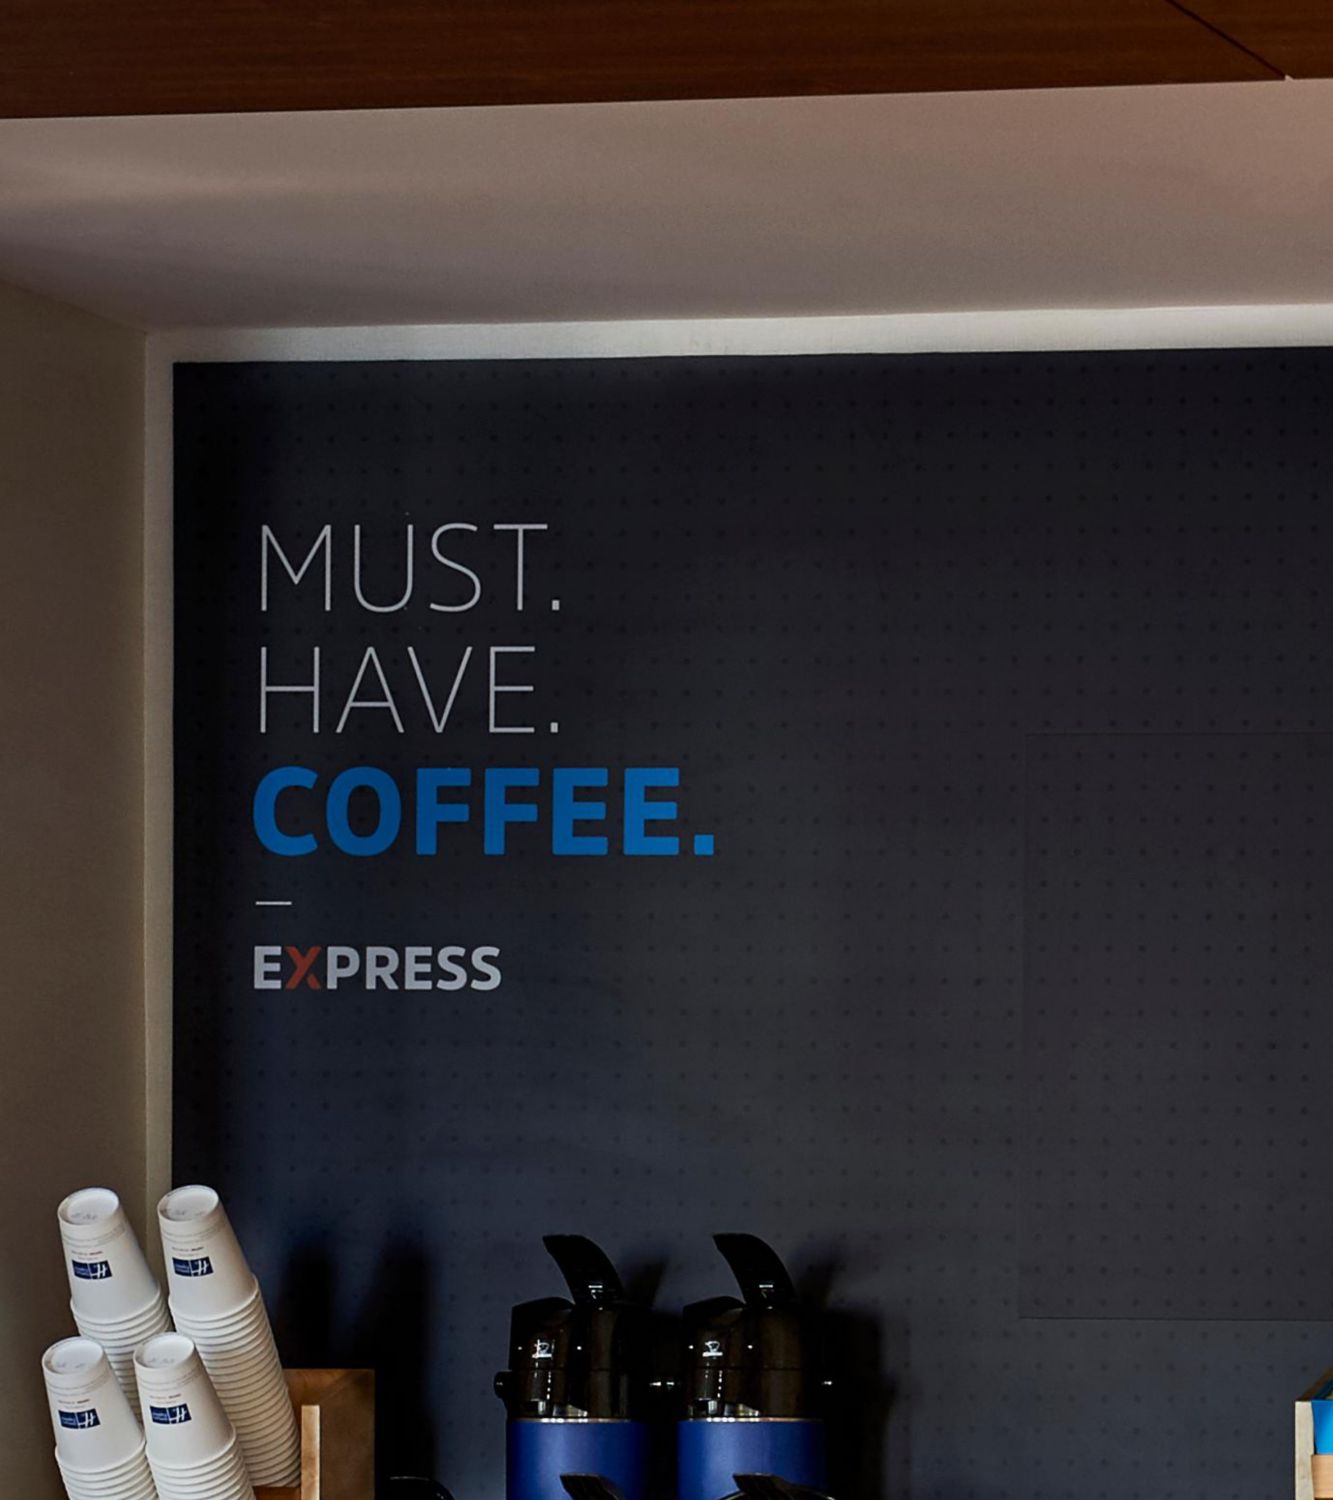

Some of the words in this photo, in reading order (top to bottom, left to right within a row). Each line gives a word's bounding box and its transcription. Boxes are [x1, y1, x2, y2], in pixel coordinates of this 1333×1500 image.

[261, 523, 560, 612] MUST.
[260, 646, 559, 733] HAVE.
[252, 766, 715, 856] COFFEE.
[253, 946, 502, 990] EXPRESS
